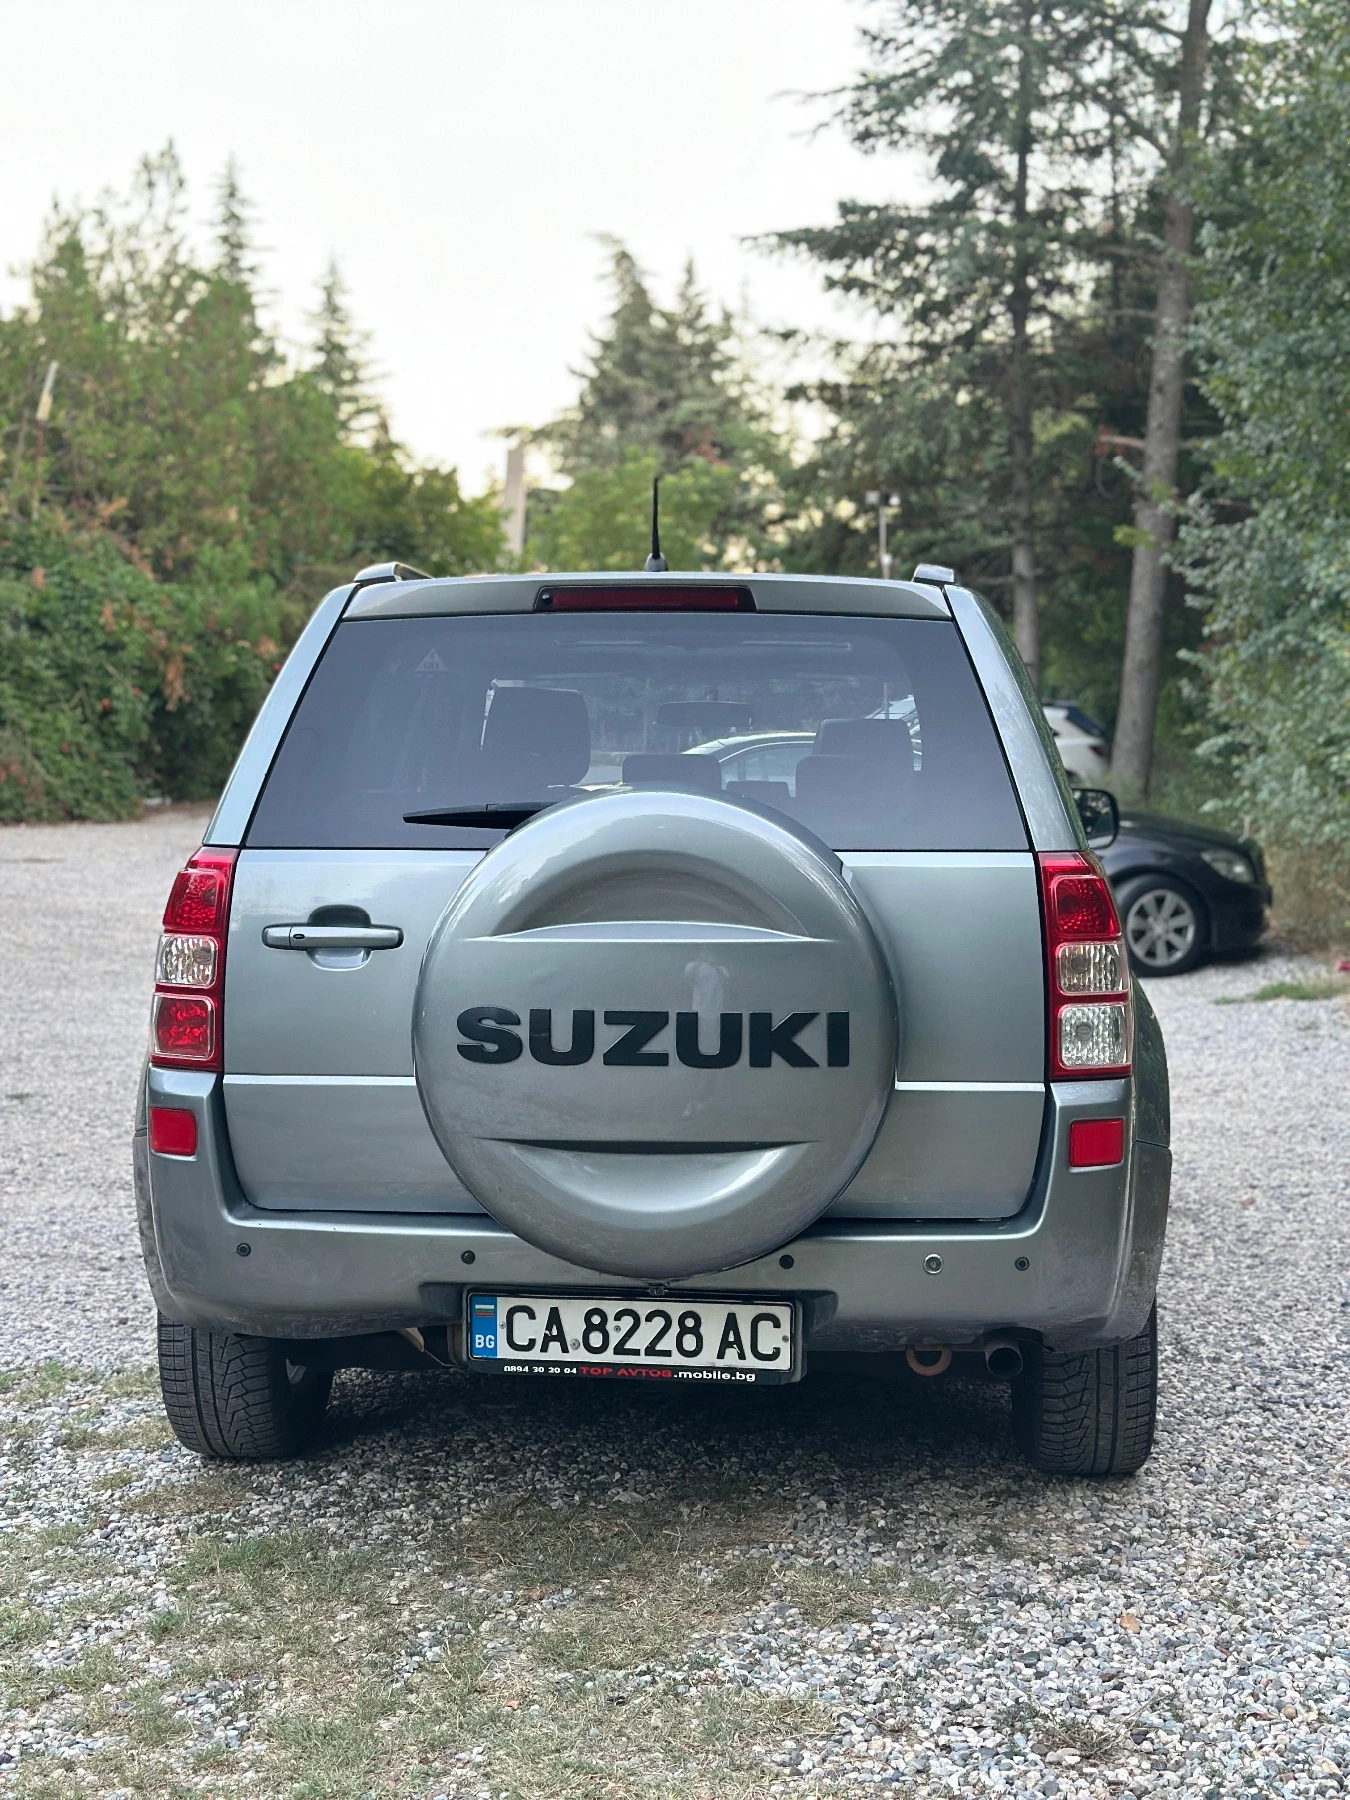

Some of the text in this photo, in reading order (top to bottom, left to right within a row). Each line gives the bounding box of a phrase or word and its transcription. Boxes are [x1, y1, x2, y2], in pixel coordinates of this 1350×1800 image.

[456, 1006, 850, 1068] SUZUKI
[475, 1334, 495, 1349] BG
[506, 1304, 782, 1361] CA 8228 AC
[503, 1365, 529, 1373] 0894
[580, 1366, 613, 1376] TOP
